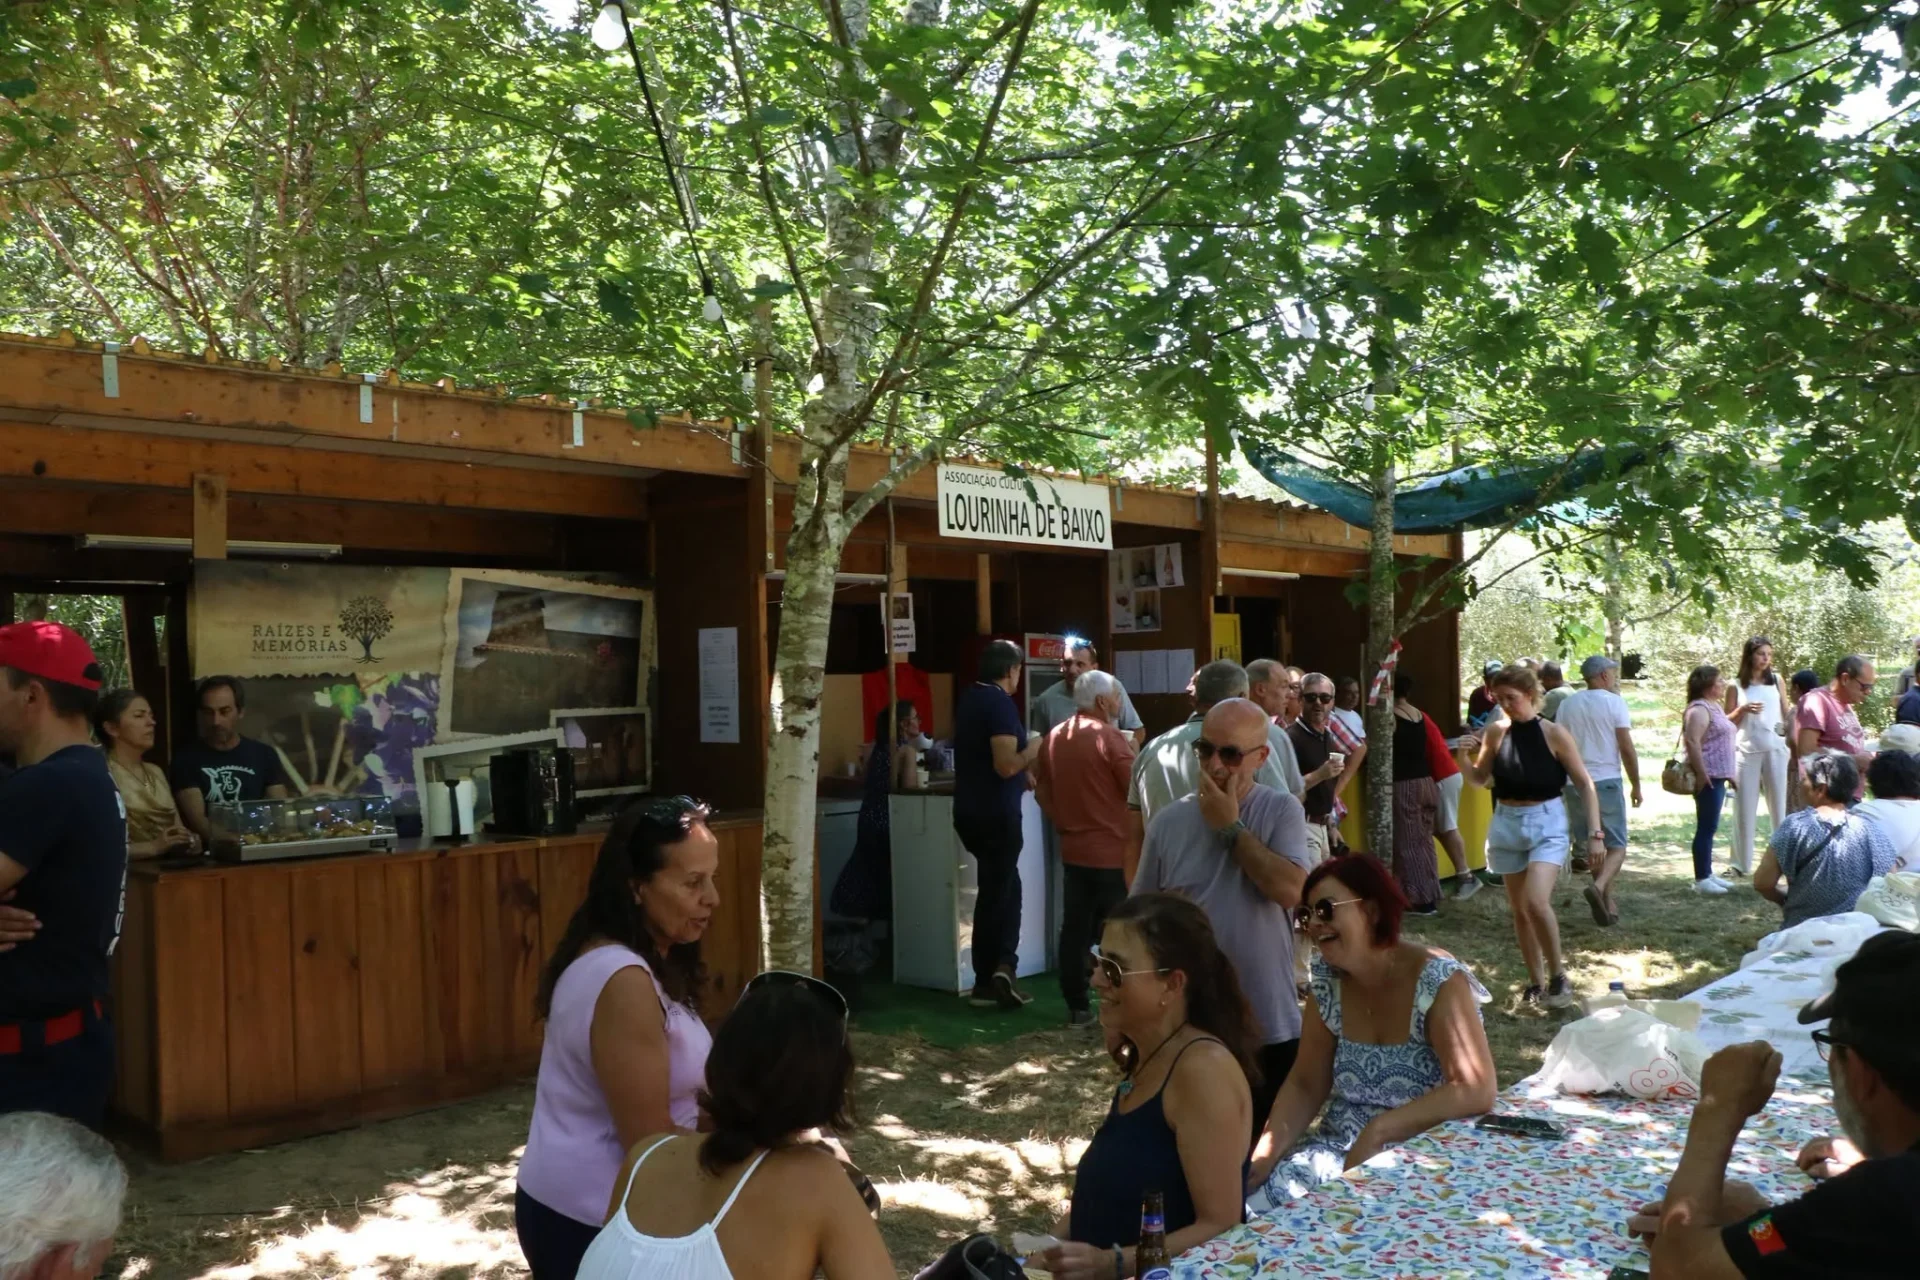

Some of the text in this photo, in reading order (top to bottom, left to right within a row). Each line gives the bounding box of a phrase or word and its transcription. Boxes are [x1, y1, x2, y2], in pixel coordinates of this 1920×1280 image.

[946, 493, 1106, 543] LOURINHA DE BAIXO
[252, 623, 331, 637] RAÍZES E
[252, 638, 348, 652] MEMÓRIAS
